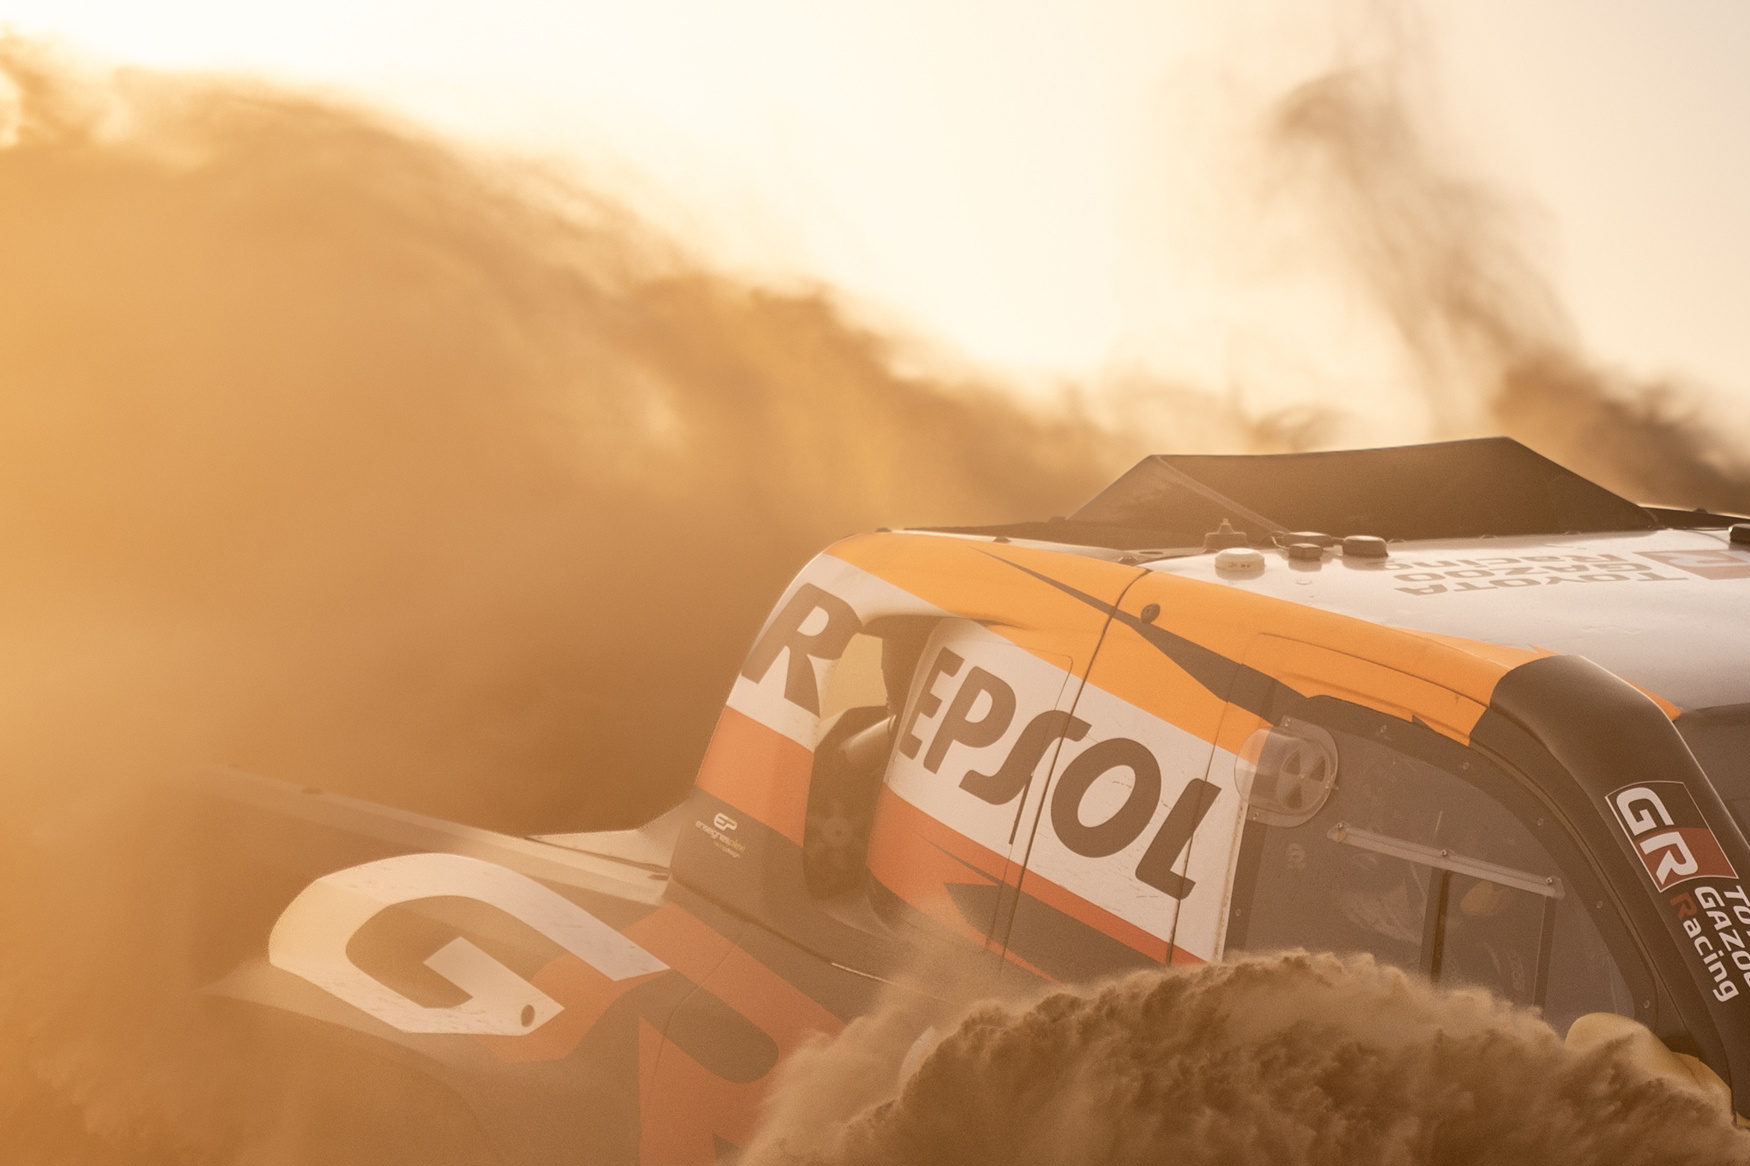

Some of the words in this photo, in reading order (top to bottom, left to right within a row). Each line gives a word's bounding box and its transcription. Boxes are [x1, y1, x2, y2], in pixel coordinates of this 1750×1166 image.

[741, 583, 1222, 900] REPSOL
[1616, 787, 1698, 885] GR
[1669, 892, 1740, 1002] Racing
